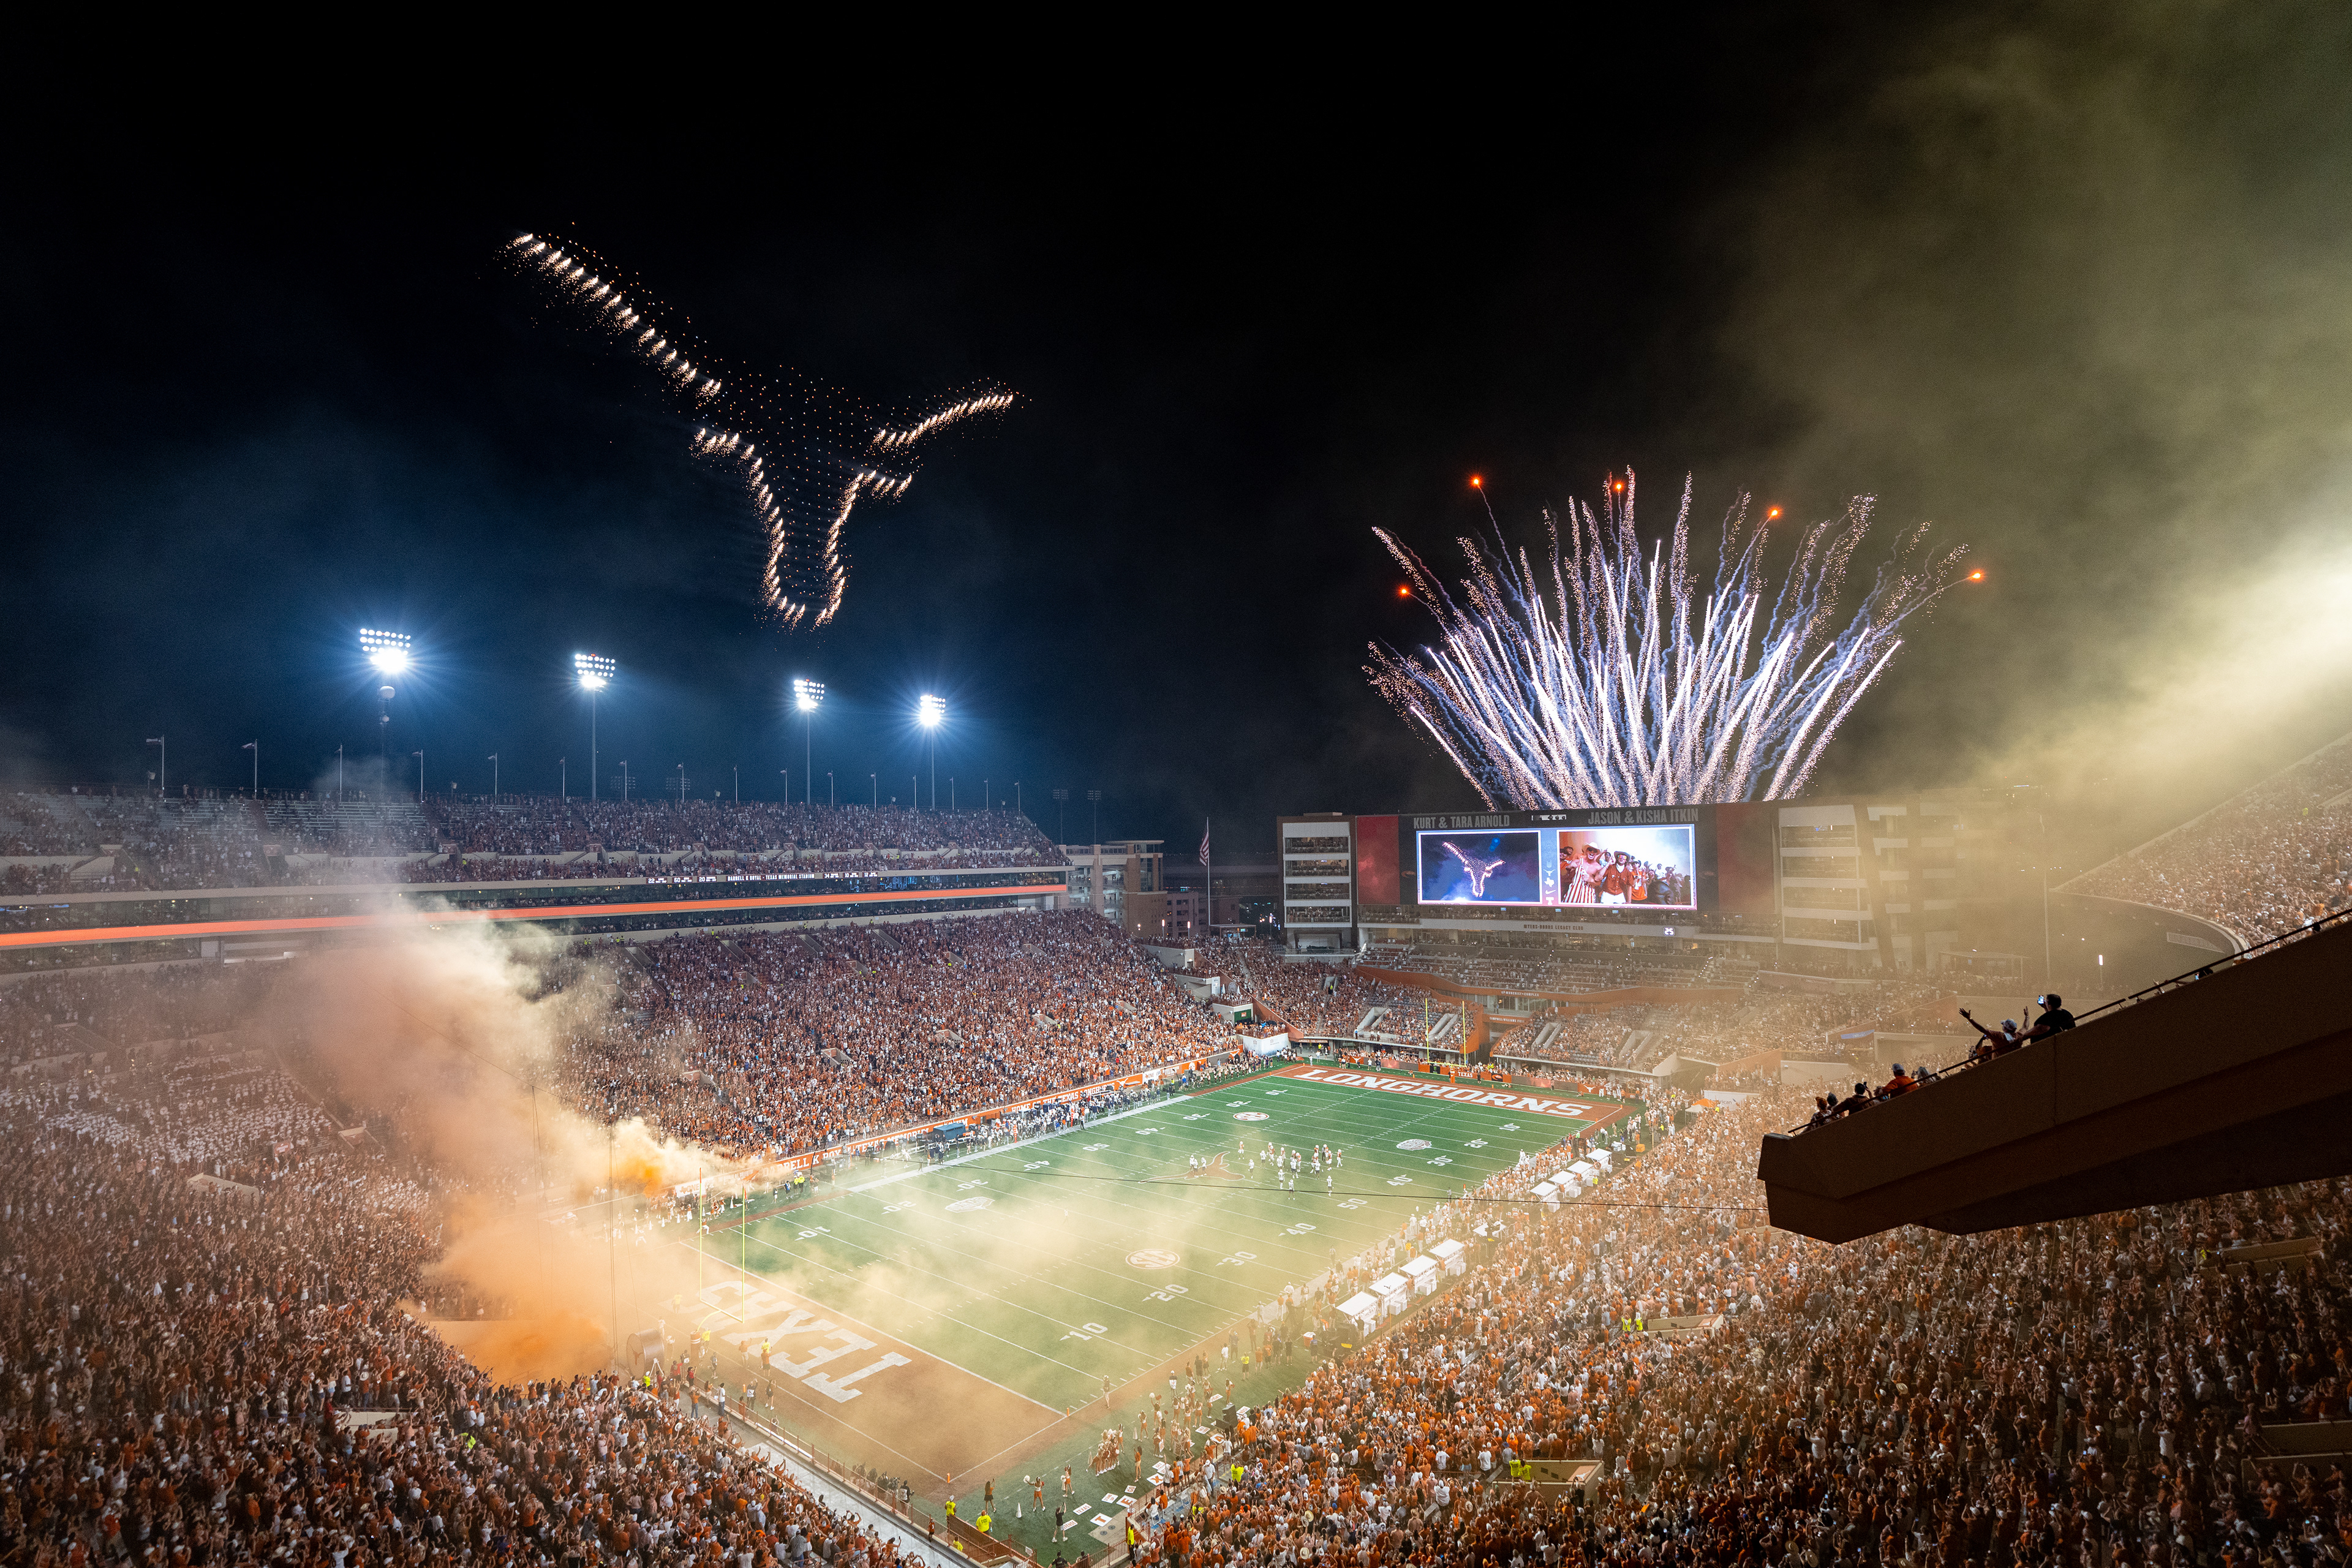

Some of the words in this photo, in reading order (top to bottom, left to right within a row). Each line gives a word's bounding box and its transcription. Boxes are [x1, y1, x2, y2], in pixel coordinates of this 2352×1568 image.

[1414, 817, 1436, 829] KURT
[1439, 816, 1448, 828] &
[1450, 816, 1473, 827] TARA
[1475, 815, 1510, 827] ARNOLD
[1588, 812, 1621, 824] JASON
[1624, 810, 1634, 823] &
[1637, 809, 1667, 823] KISHA
[1670, 809, 1698, 822] ITKIN
[1294, 1069, 1591, 1116] LONGHORNS
[1011, 1102, 1030, 1112] HOME
[1043, 1096, 1057, 1105] THE
[1058, 1091, 1079, 1103] TEXAS
[1082, 1143, 1110, 1152] 50
[1464, 1139, 1489, 1148] 20
[812, 1155, 820, 1165] K
[1023, 1161, 1050, 1169] 40
[1427, 1156, 1453, 1166] 30
[957, 1180, 989, 1189] 30
[1386, 1176, 1413, 1186] 40
[883, 1200, 917, 1212] 20
[1336, 1198, 1368, 1210] 50
[798, 1226, 831, 1237] 10
[1286, 1223, 1316, 1235] 40
[1130, 1250, 1176, 1267] SEC
[1222, 1251, 1257, 1265] 30
[1150, 1284, 1189, 1302] 20
[1069, 1322, 1108, 1341] 10
[657, 1280, 913, 1403] TEXAS
[1150, 1475, 1163, 1483] X
[1076, 1505, 1090, 1513] TEXAS
